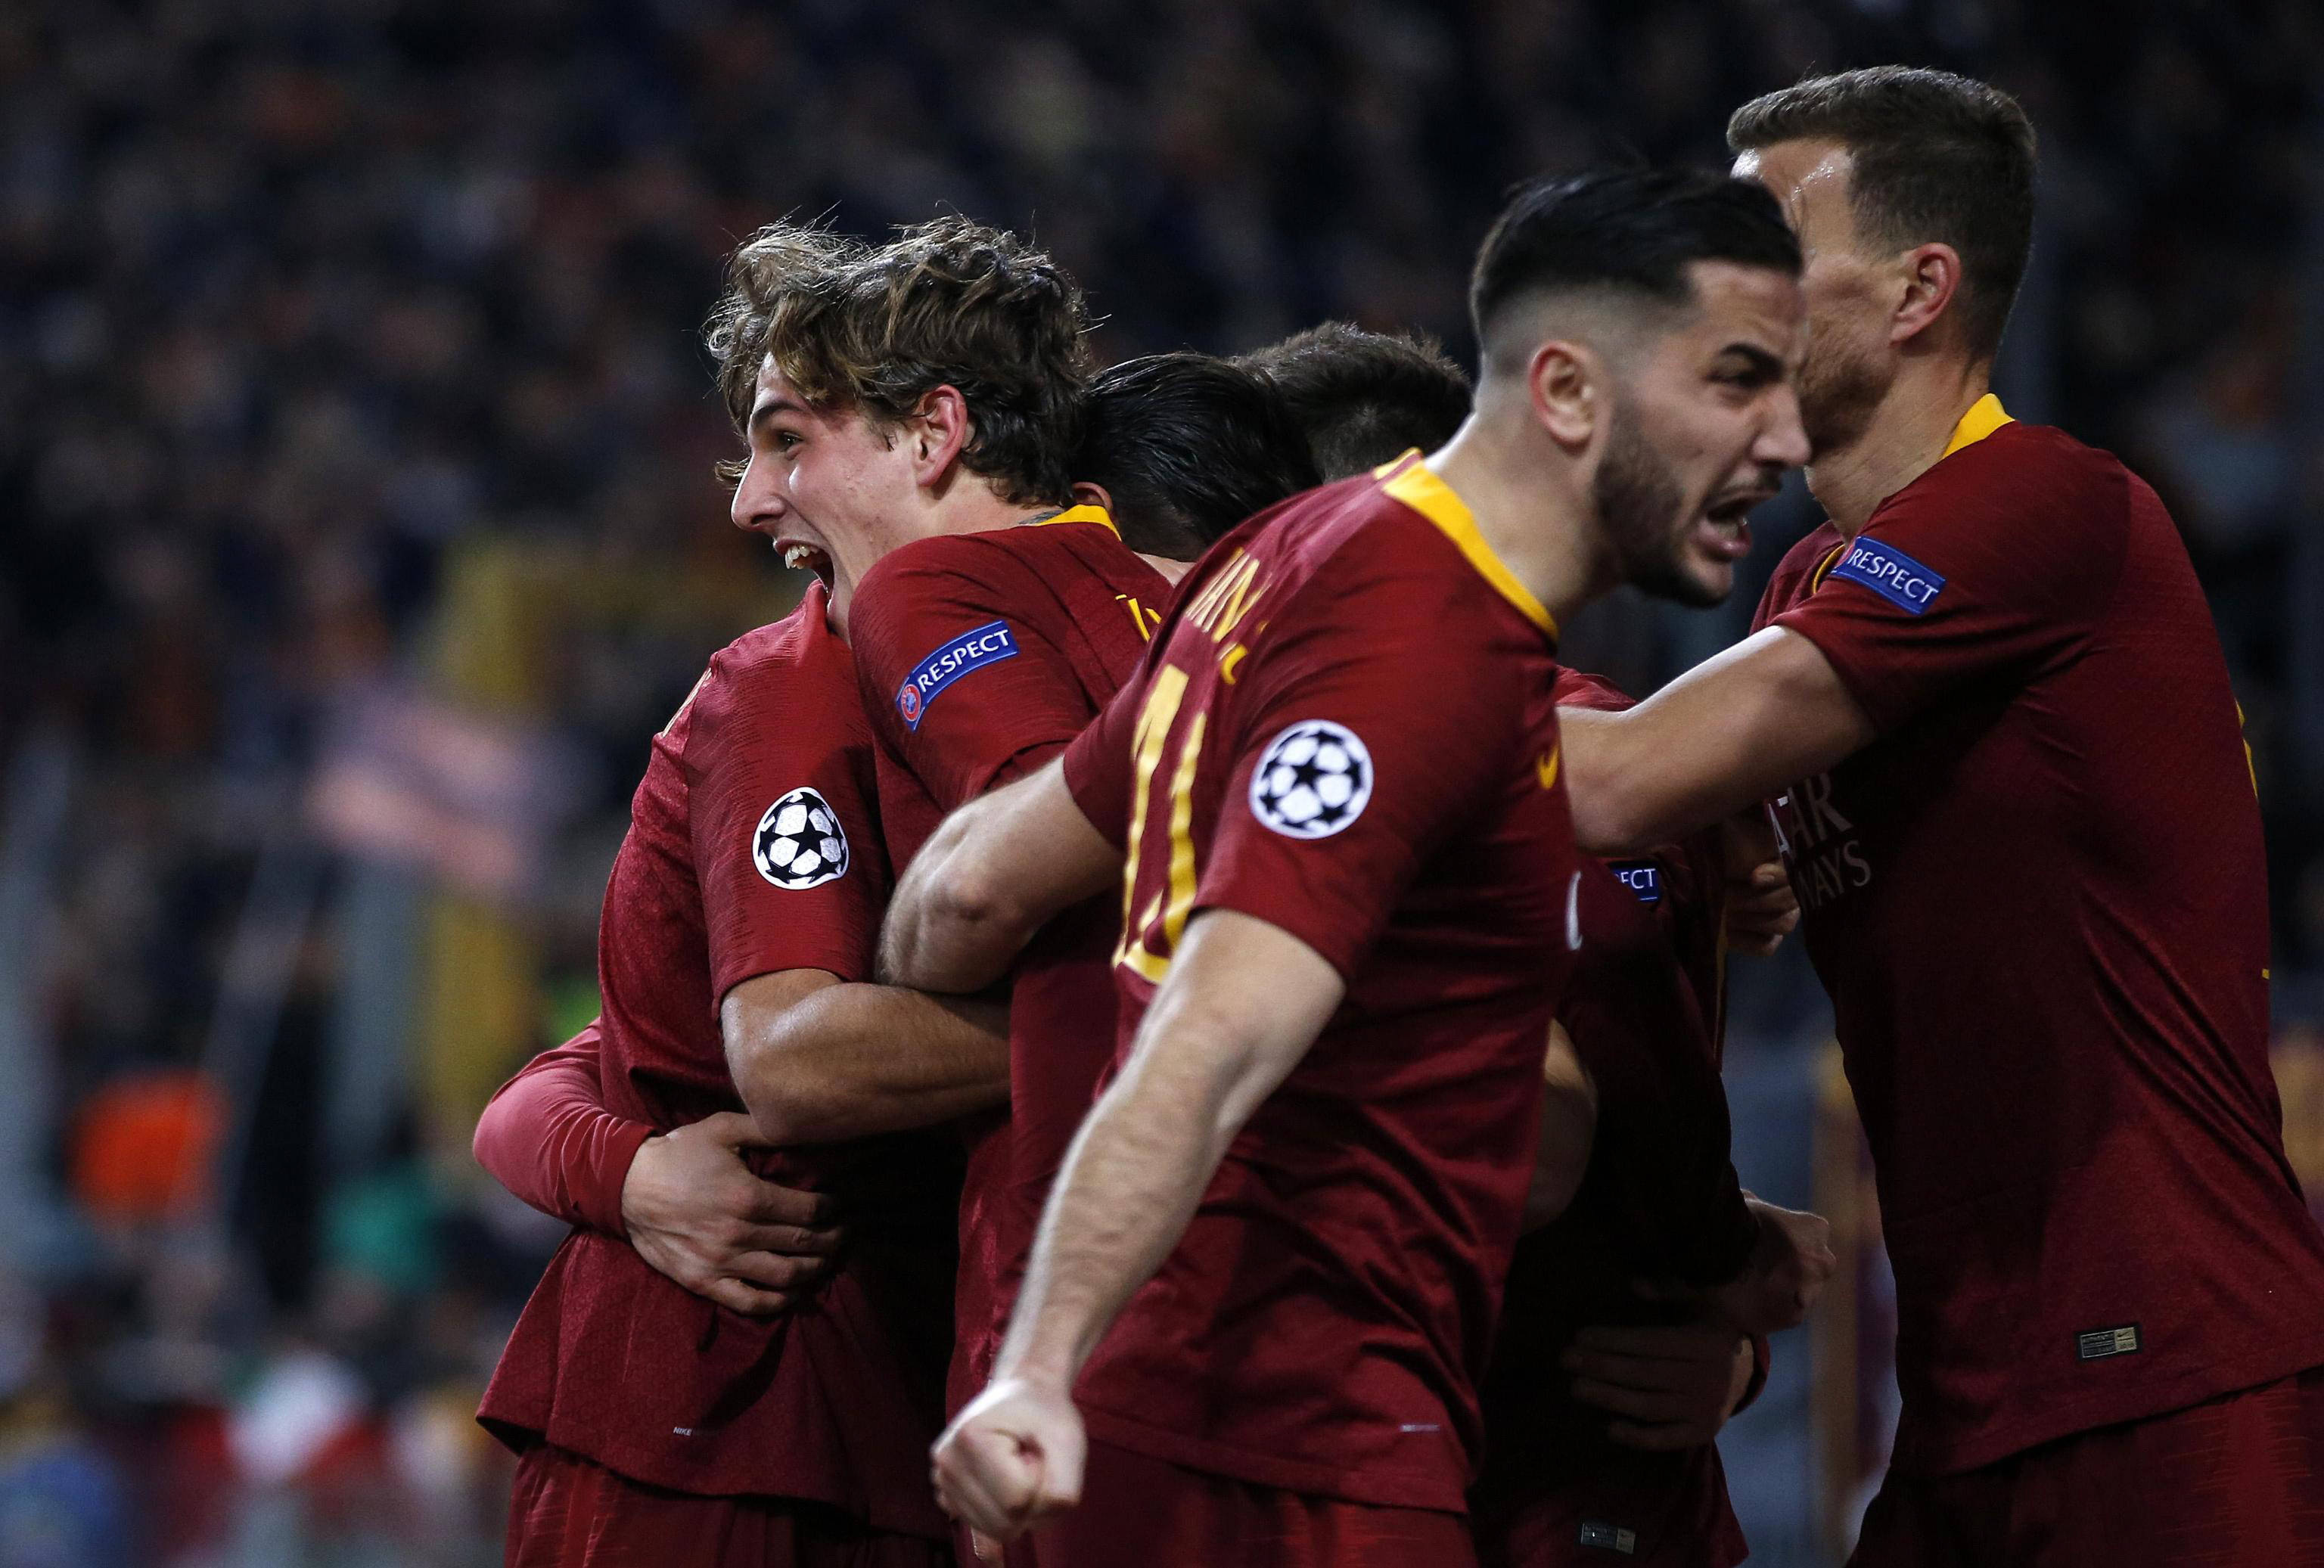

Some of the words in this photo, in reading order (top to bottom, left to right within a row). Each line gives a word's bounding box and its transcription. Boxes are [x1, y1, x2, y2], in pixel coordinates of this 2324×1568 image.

[1847, 548, 1940, 604] RESPECT
[916, 629, 1009, 693] RESPECT
[673, 1426, 693, 1436] NIKE
